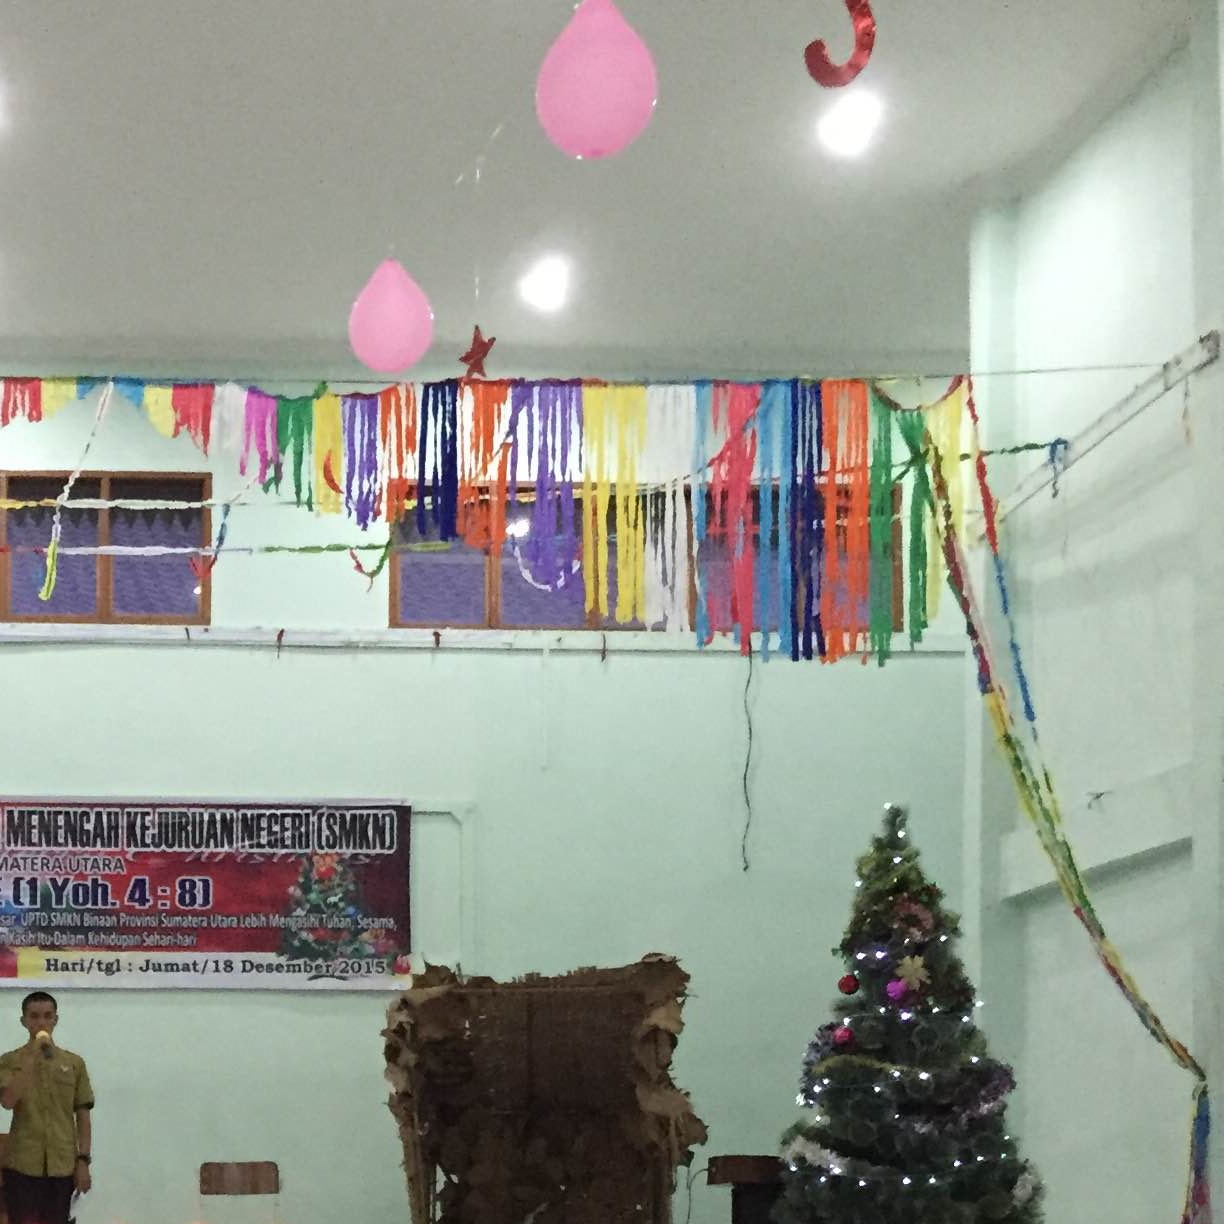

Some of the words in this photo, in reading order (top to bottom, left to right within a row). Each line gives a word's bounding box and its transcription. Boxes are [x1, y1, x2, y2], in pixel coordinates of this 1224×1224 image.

[6, 810, 120, 849] MENENGAH
[126, 811, 235, 849] KEJURUAN
[240, 812, 311, 850] NEGERI
[69, 857, 125, 872] UTARA
[49, 877, 117, 907] Yoh.
[127, 878, 151, 907] 4
[21, 913, 47, 927] UPTD
[51, 913, 80, 927] SMKN
[84, 913, 116, 927] Binaan
[120, 913, 158, 927] Provinsi
[161, 914, 208, 928] Sumatera
[211, 915, 237, 928] Utara
[241, 915, 269, 928] Lebih
[88, 932, 139, 949] Kehidupan
[45, 958, 122, 976] Hari/tgl
[139, 958, 234, 975] Jumat/18
[242, 959, 332, 975] Desember
[340, 960, 386, 975] 2015
